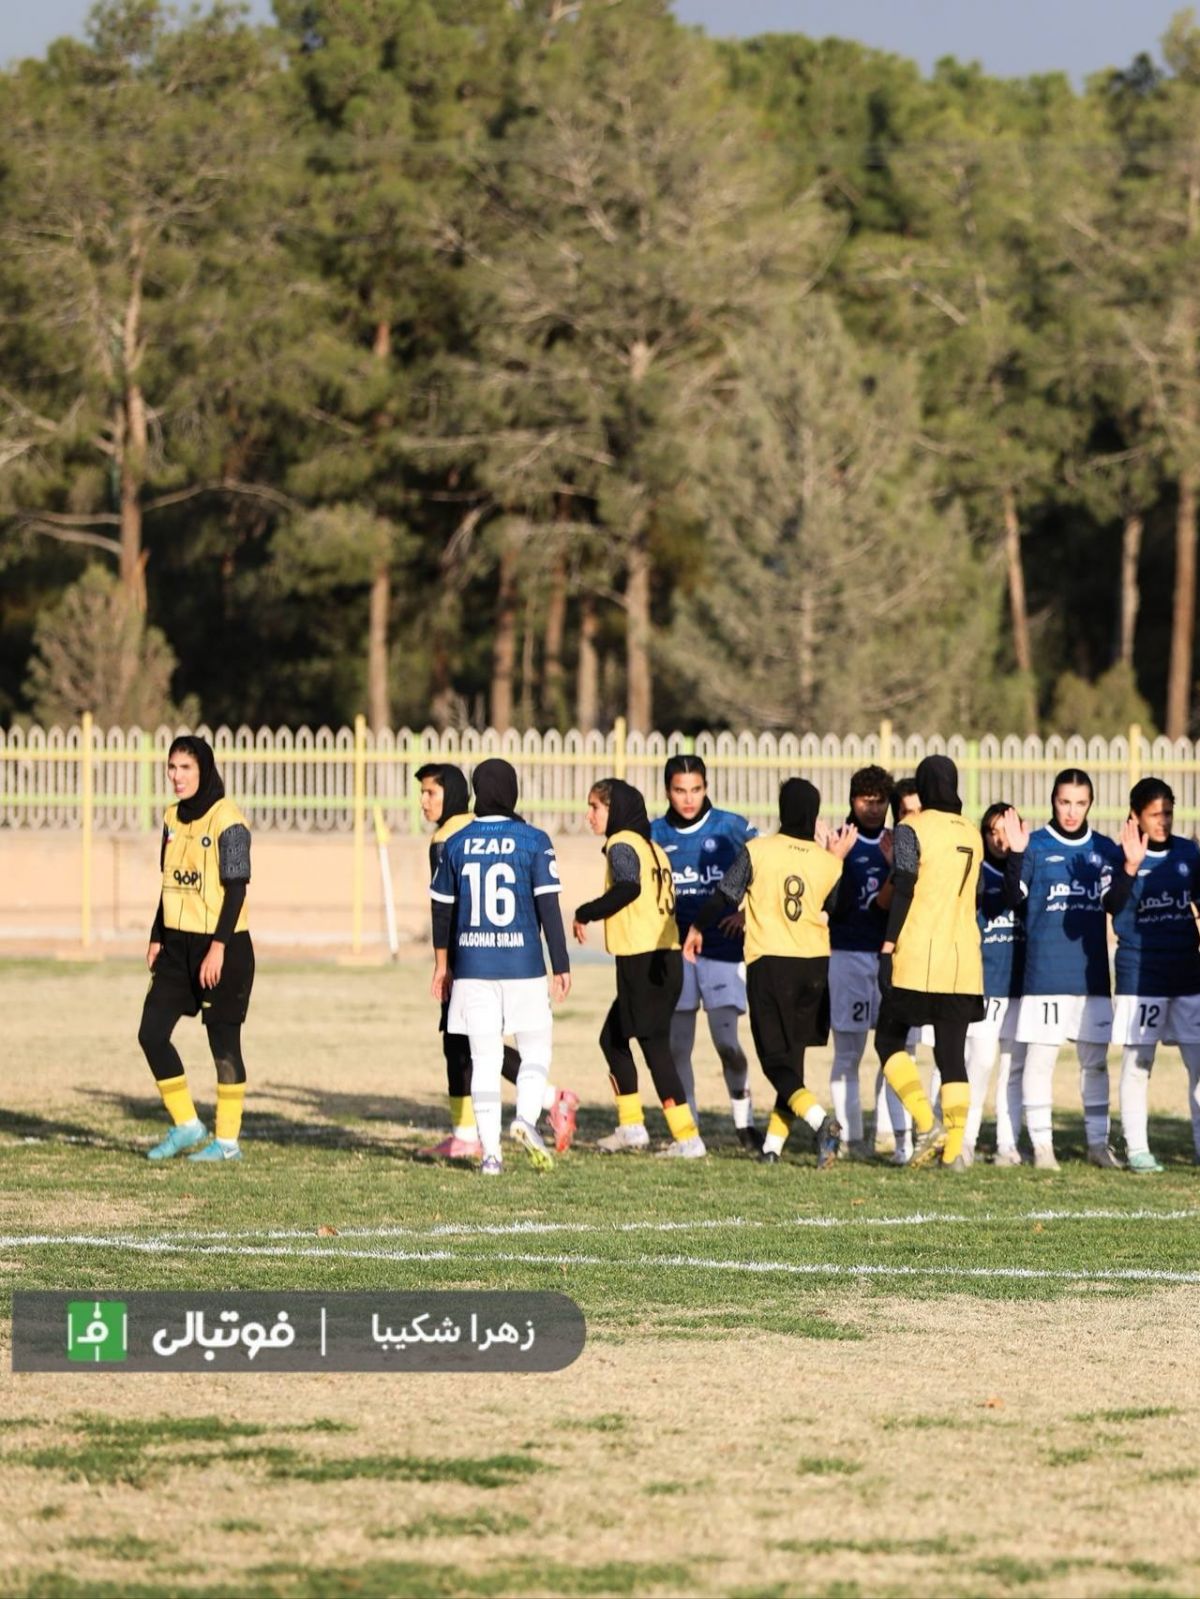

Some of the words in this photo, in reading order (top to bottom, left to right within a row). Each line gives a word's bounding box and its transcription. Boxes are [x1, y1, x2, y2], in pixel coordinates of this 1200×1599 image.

[463, 838, 516, 855] IZAD
[672, 865, 699, 884] گه
[956, 846, 973, 897] 7
[461, 862, 516, 928] 16
[784, 874, 805, 923] 8
[1046, 879, 1086, 901] گهر
[496, 931, 525, 948] SIRJAN
[852, 1001, 870, 1022] 21
[1043, 1002, 1059, 1025] 11
[1139, 1004, 1161, 1029] 12
